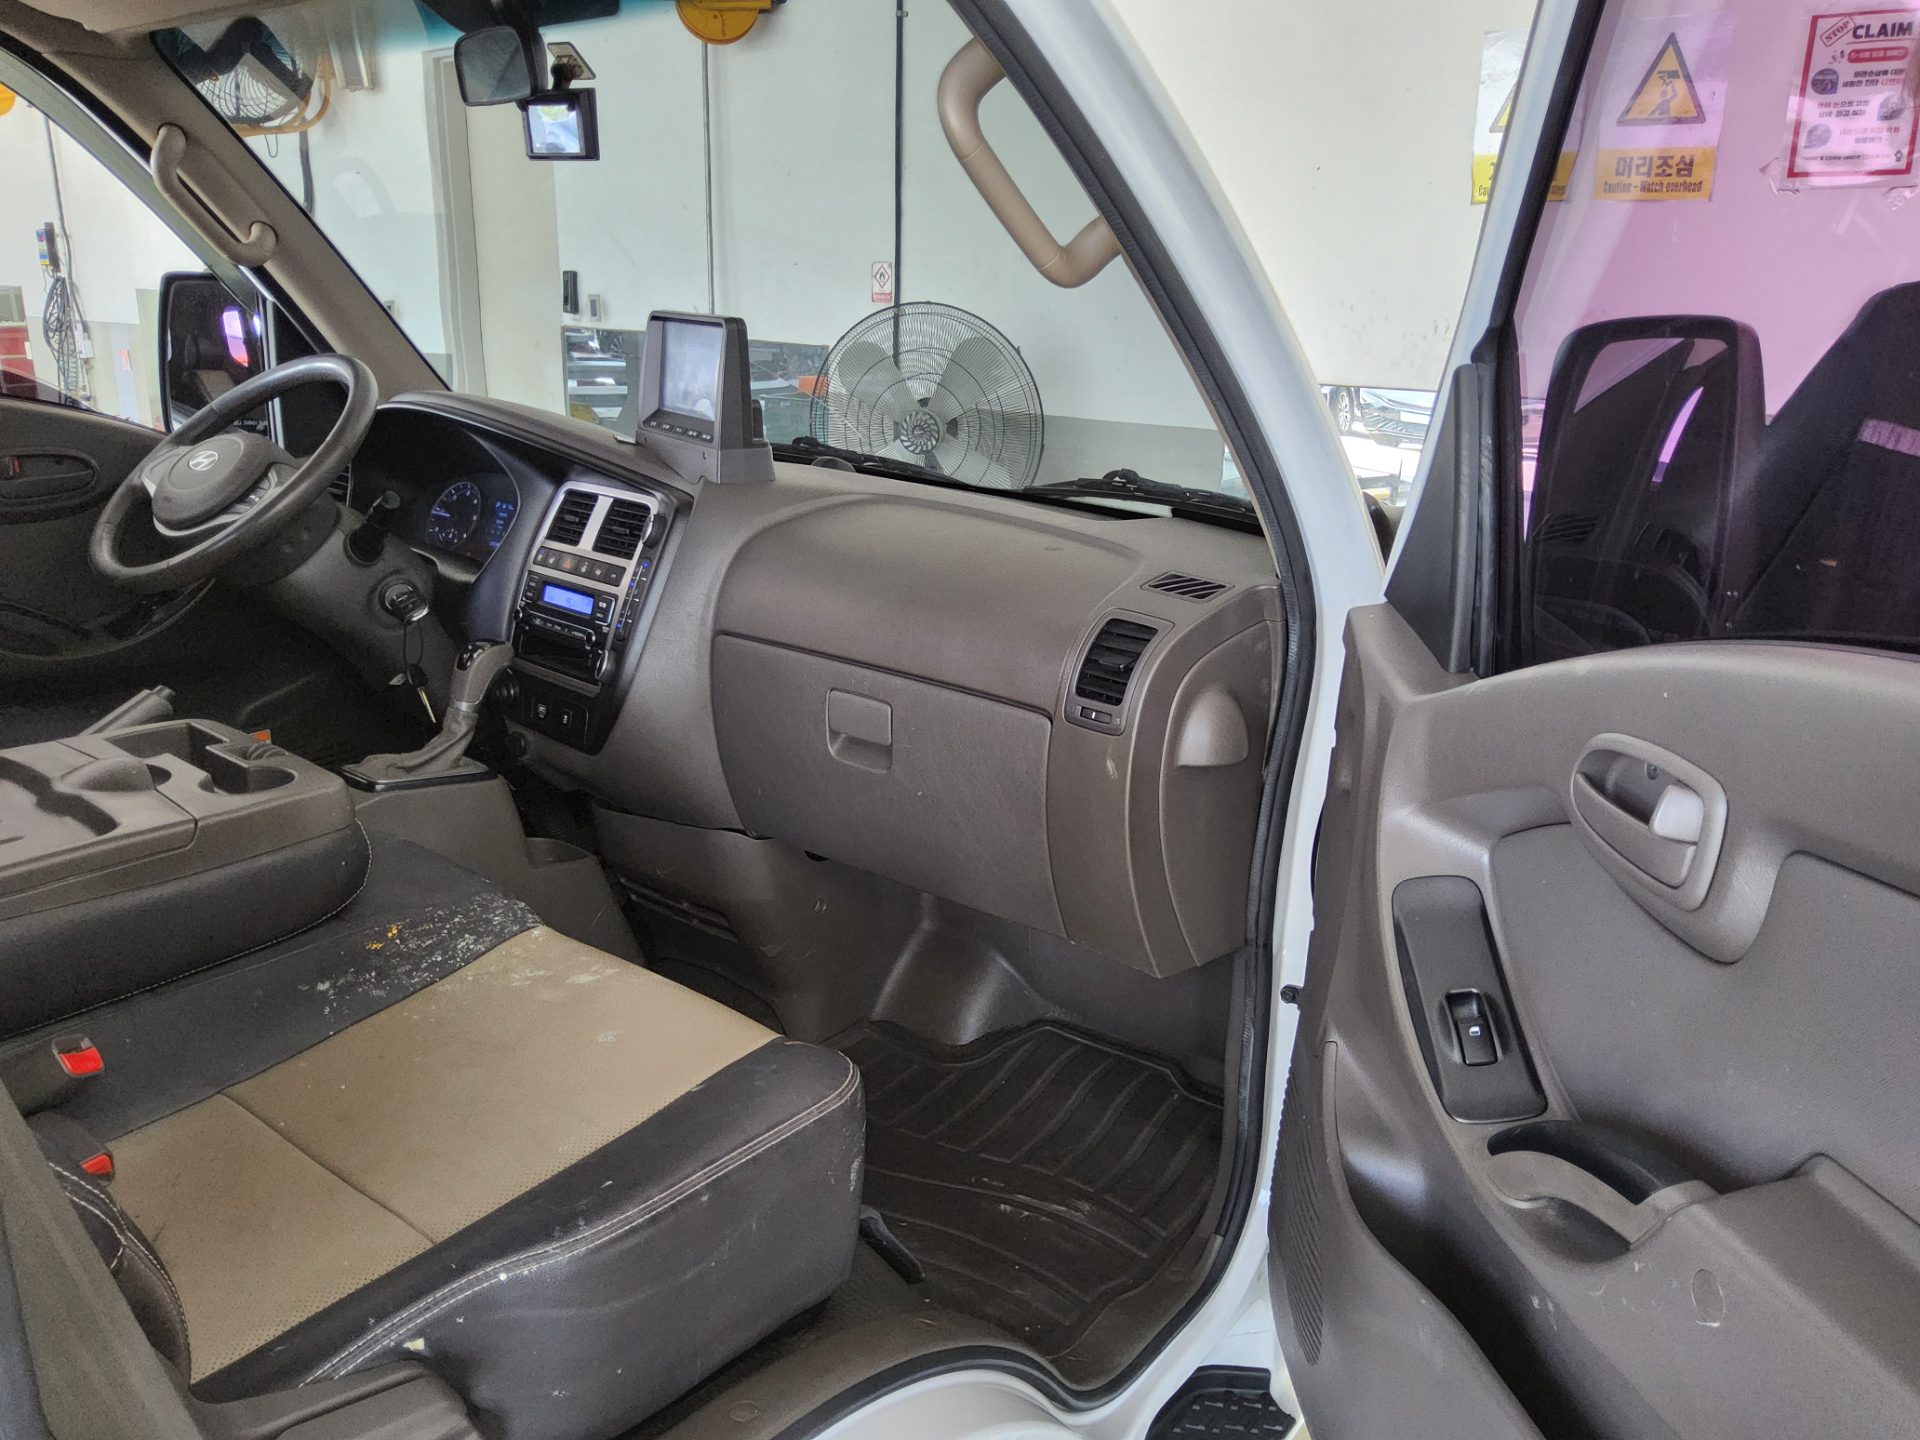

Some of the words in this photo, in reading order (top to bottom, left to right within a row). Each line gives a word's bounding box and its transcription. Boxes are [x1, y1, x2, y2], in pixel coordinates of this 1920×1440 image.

[1824, 20, 1851, 44] STOP
[1852, 21, 1913, 40] CLAIM
[1615, 154, 1696, 179] 머리조심
[1603, 180, 1632, 193] Caution
[1640, 180, 1664, 193] Watch
[1665, 180, 1703, 193] overhead
